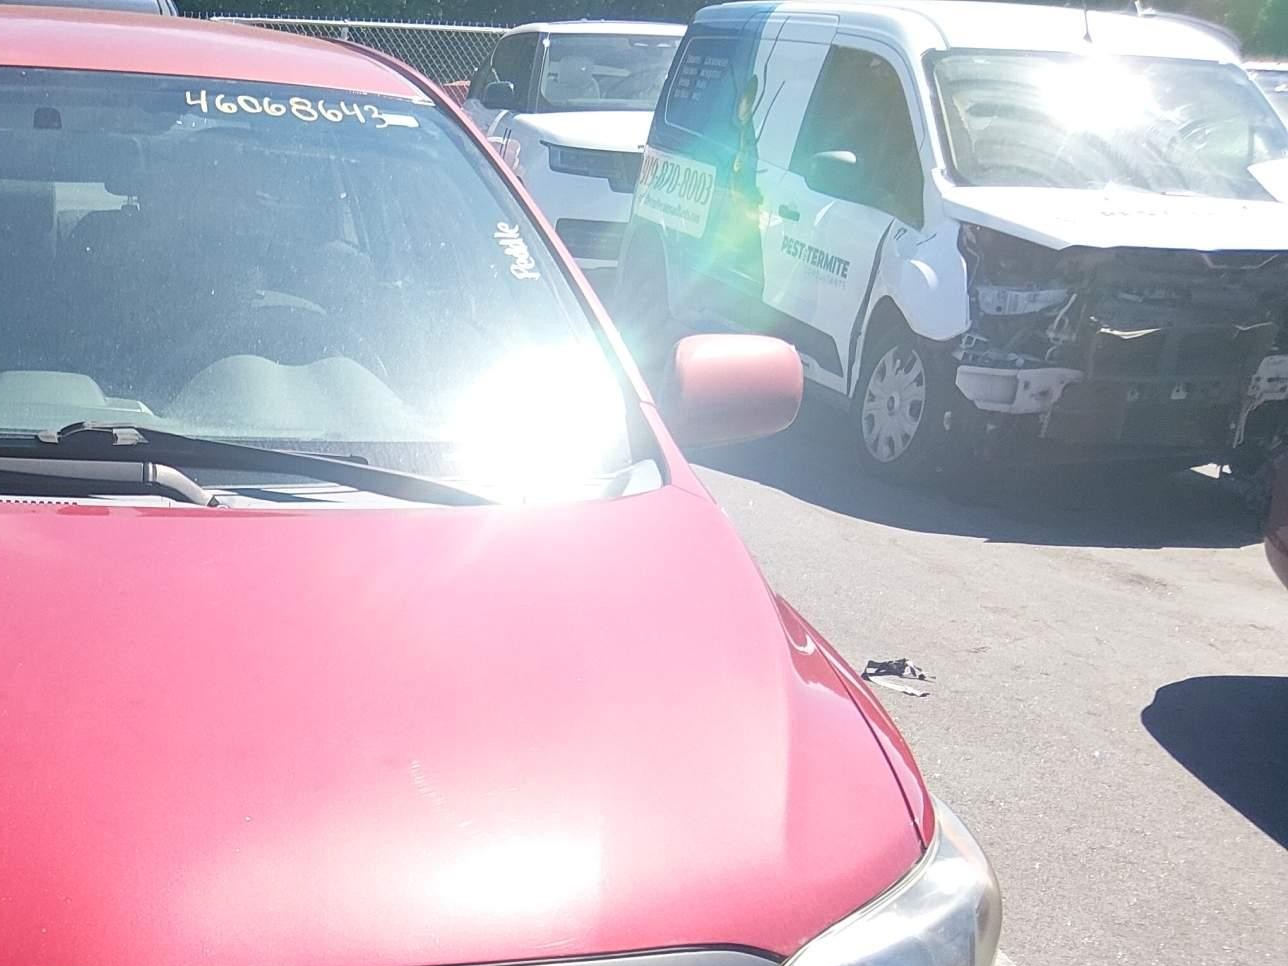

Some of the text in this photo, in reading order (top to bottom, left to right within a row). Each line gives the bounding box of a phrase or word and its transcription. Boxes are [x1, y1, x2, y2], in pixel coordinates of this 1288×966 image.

[185, 90, 389, 128] 46068643
[781, 235, 806, 260] PEST
[806, 246, 850, 279] TERMITE
